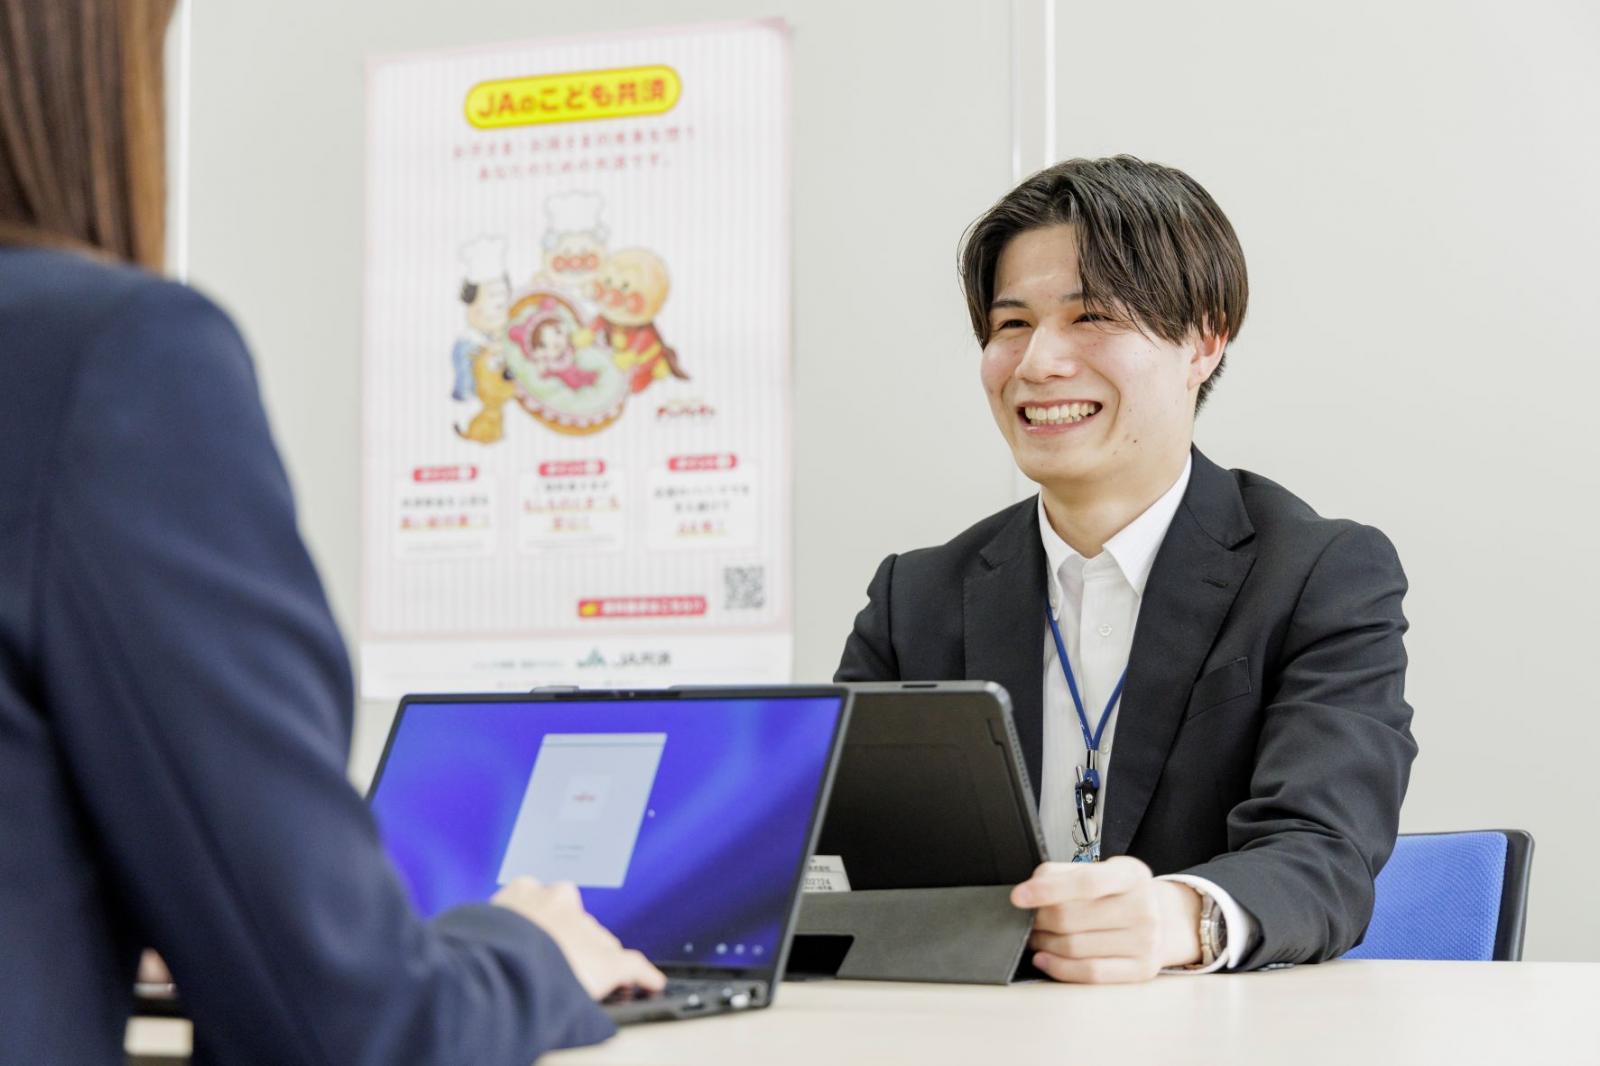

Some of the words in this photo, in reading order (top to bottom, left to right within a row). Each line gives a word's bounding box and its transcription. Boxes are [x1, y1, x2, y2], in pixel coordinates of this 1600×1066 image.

[478, 78, 666, 119] JAのこども共済
